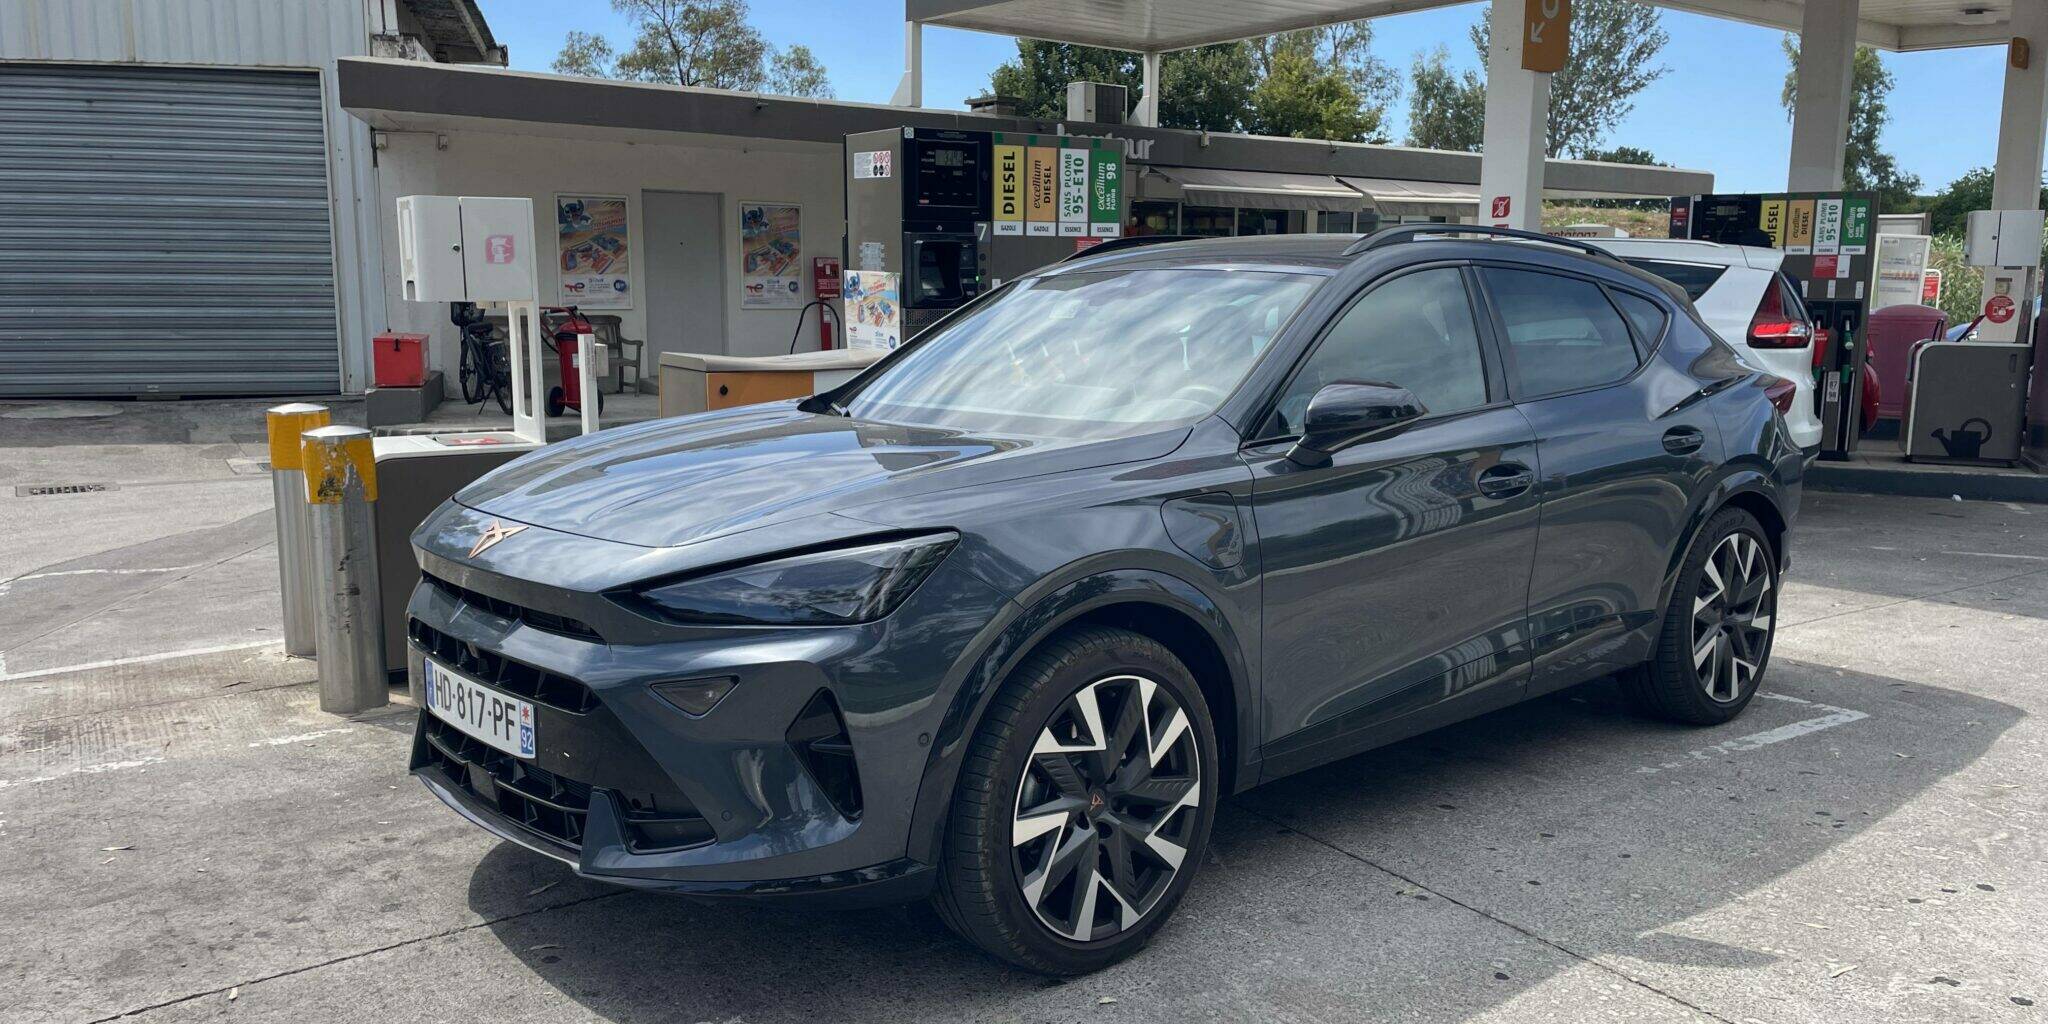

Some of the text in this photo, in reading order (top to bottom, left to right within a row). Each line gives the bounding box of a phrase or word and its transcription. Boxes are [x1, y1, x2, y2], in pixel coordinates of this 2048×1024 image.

[1003, 151, 1015, 215] DIESEL
[1032, 160, 1042, 209] excellium
[1043, 166, 1052, 204] DIESEL
[1064, 153, 1073, 218] SANS PLOMB
[1072, 157, 1085, 214] 95-E10
[1095, 162, 1106, 210] excellium
[1106, 162, 1117, 180] 98
[1767, 203, 1780, 242] DIESEL
[1801, 211, 1810, 235] DIESEL
[1825, 204, 1839, 241] 95-E10
[1856, 206, 1867, 219] 98
[977, 223, 987, 241] 7
[434, 669, 516, 741] HD-817-PF
[521, 729, 533, 749] 92
